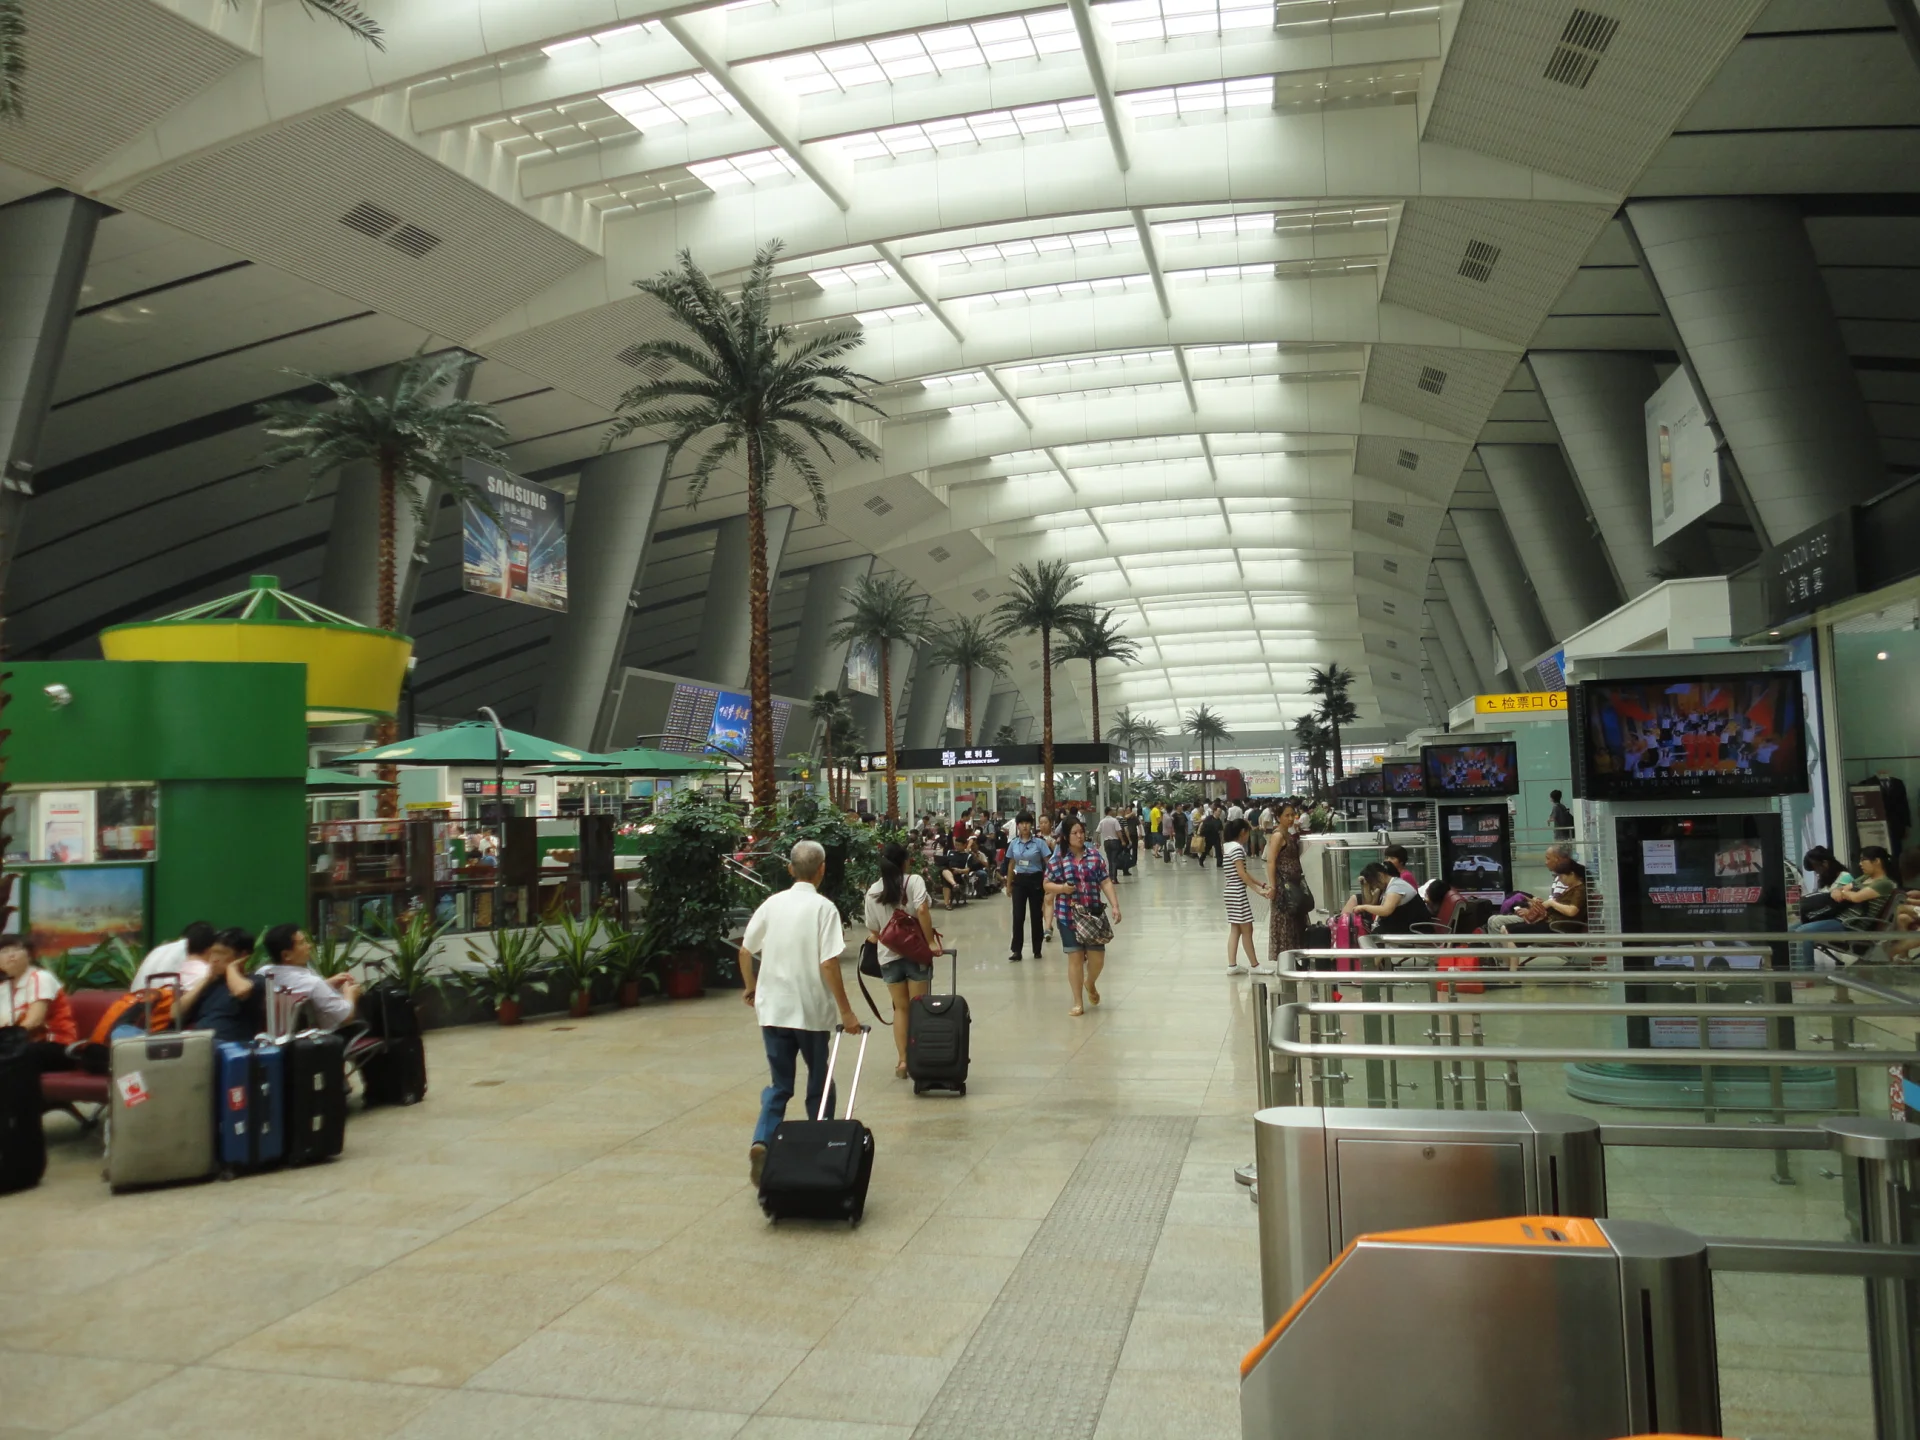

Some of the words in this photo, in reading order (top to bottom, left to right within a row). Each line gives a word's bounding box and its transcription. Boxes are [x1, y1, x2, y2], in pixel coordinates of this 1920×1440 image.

[487, 475, 547, 511] SAMSUNG
[1502, 696, 1543, 710] 检票口
[964, 750, 993, 758] 便利店
